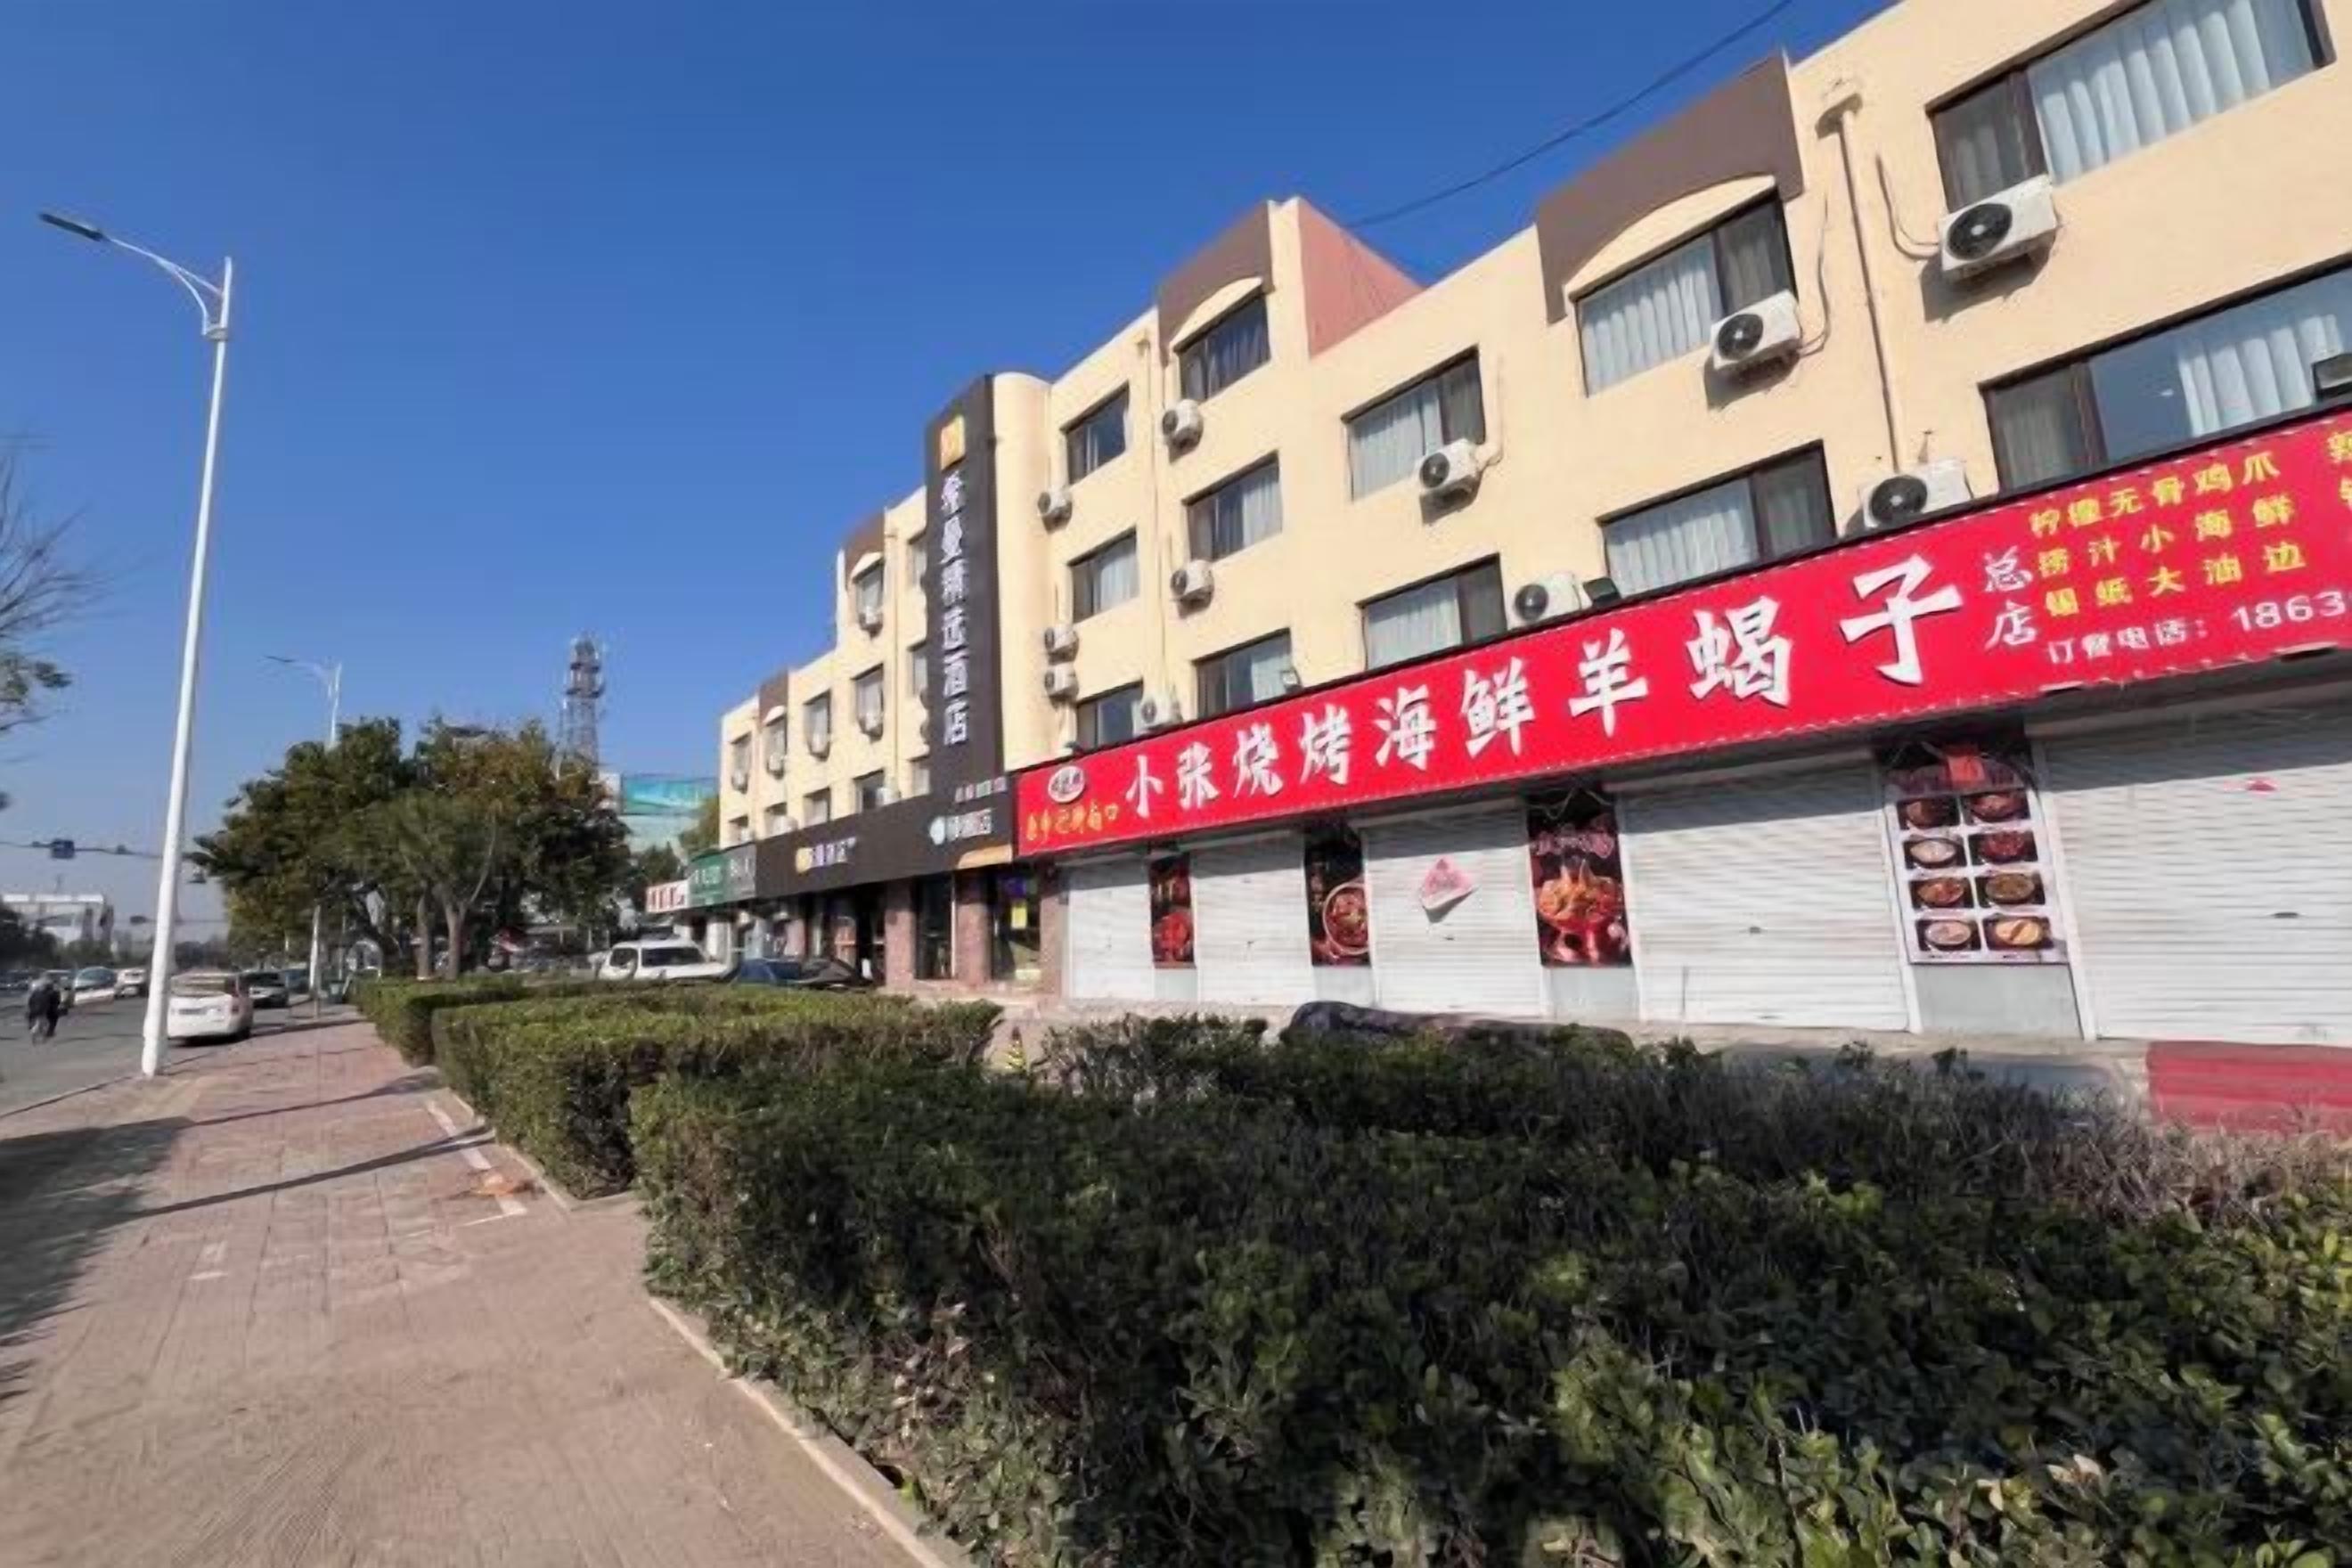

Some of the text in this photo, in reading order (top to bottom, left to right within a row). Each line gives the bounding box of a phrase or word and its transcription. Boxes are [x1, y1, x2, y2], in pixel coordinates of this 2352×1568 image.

[2031, 452, 2279, 535] 柠檬无骨鸡爪
[1986, 547, 2042, 645] 总店
[1126, 554, 1962, 817] 小张烧烤海鲜羊蝎子
